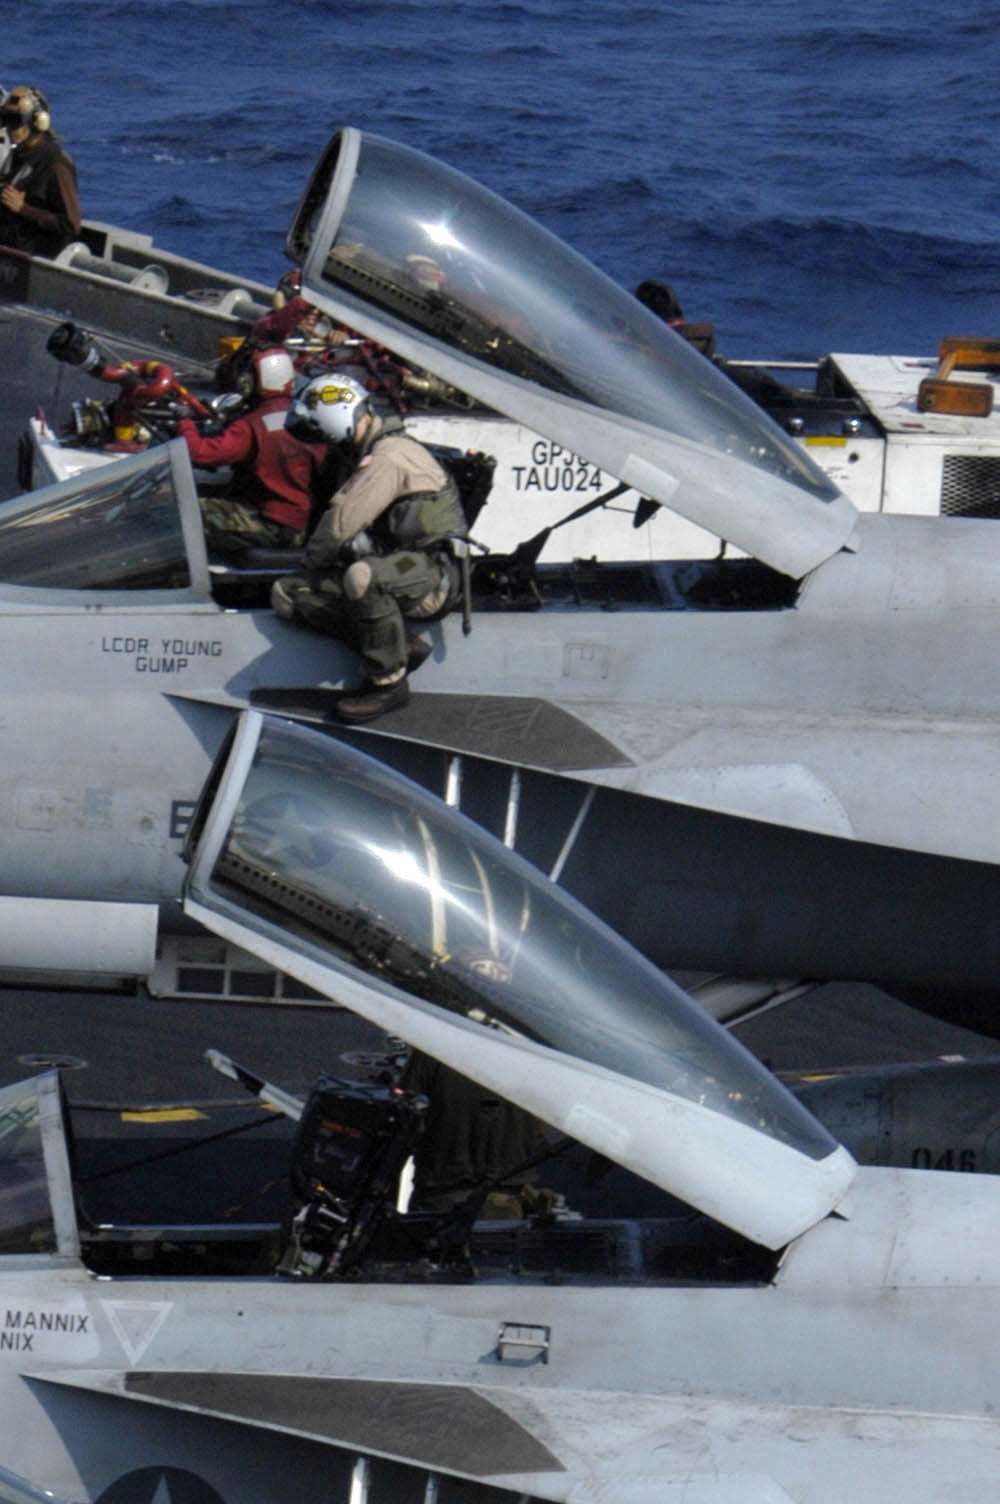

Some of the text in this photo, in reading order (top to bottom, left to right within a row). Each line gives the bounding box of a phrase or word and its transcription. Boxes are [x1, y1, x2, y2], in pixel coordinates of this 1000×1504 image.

[511, 466, 603, 492] TAU024
[101, 636, 223, 657] LCDR YOUNG
[135, 656, 188, 673] GUMP
[4, 1309, 90, 1334] MANNIX
[0, 1331, 36, 1352] NIX
